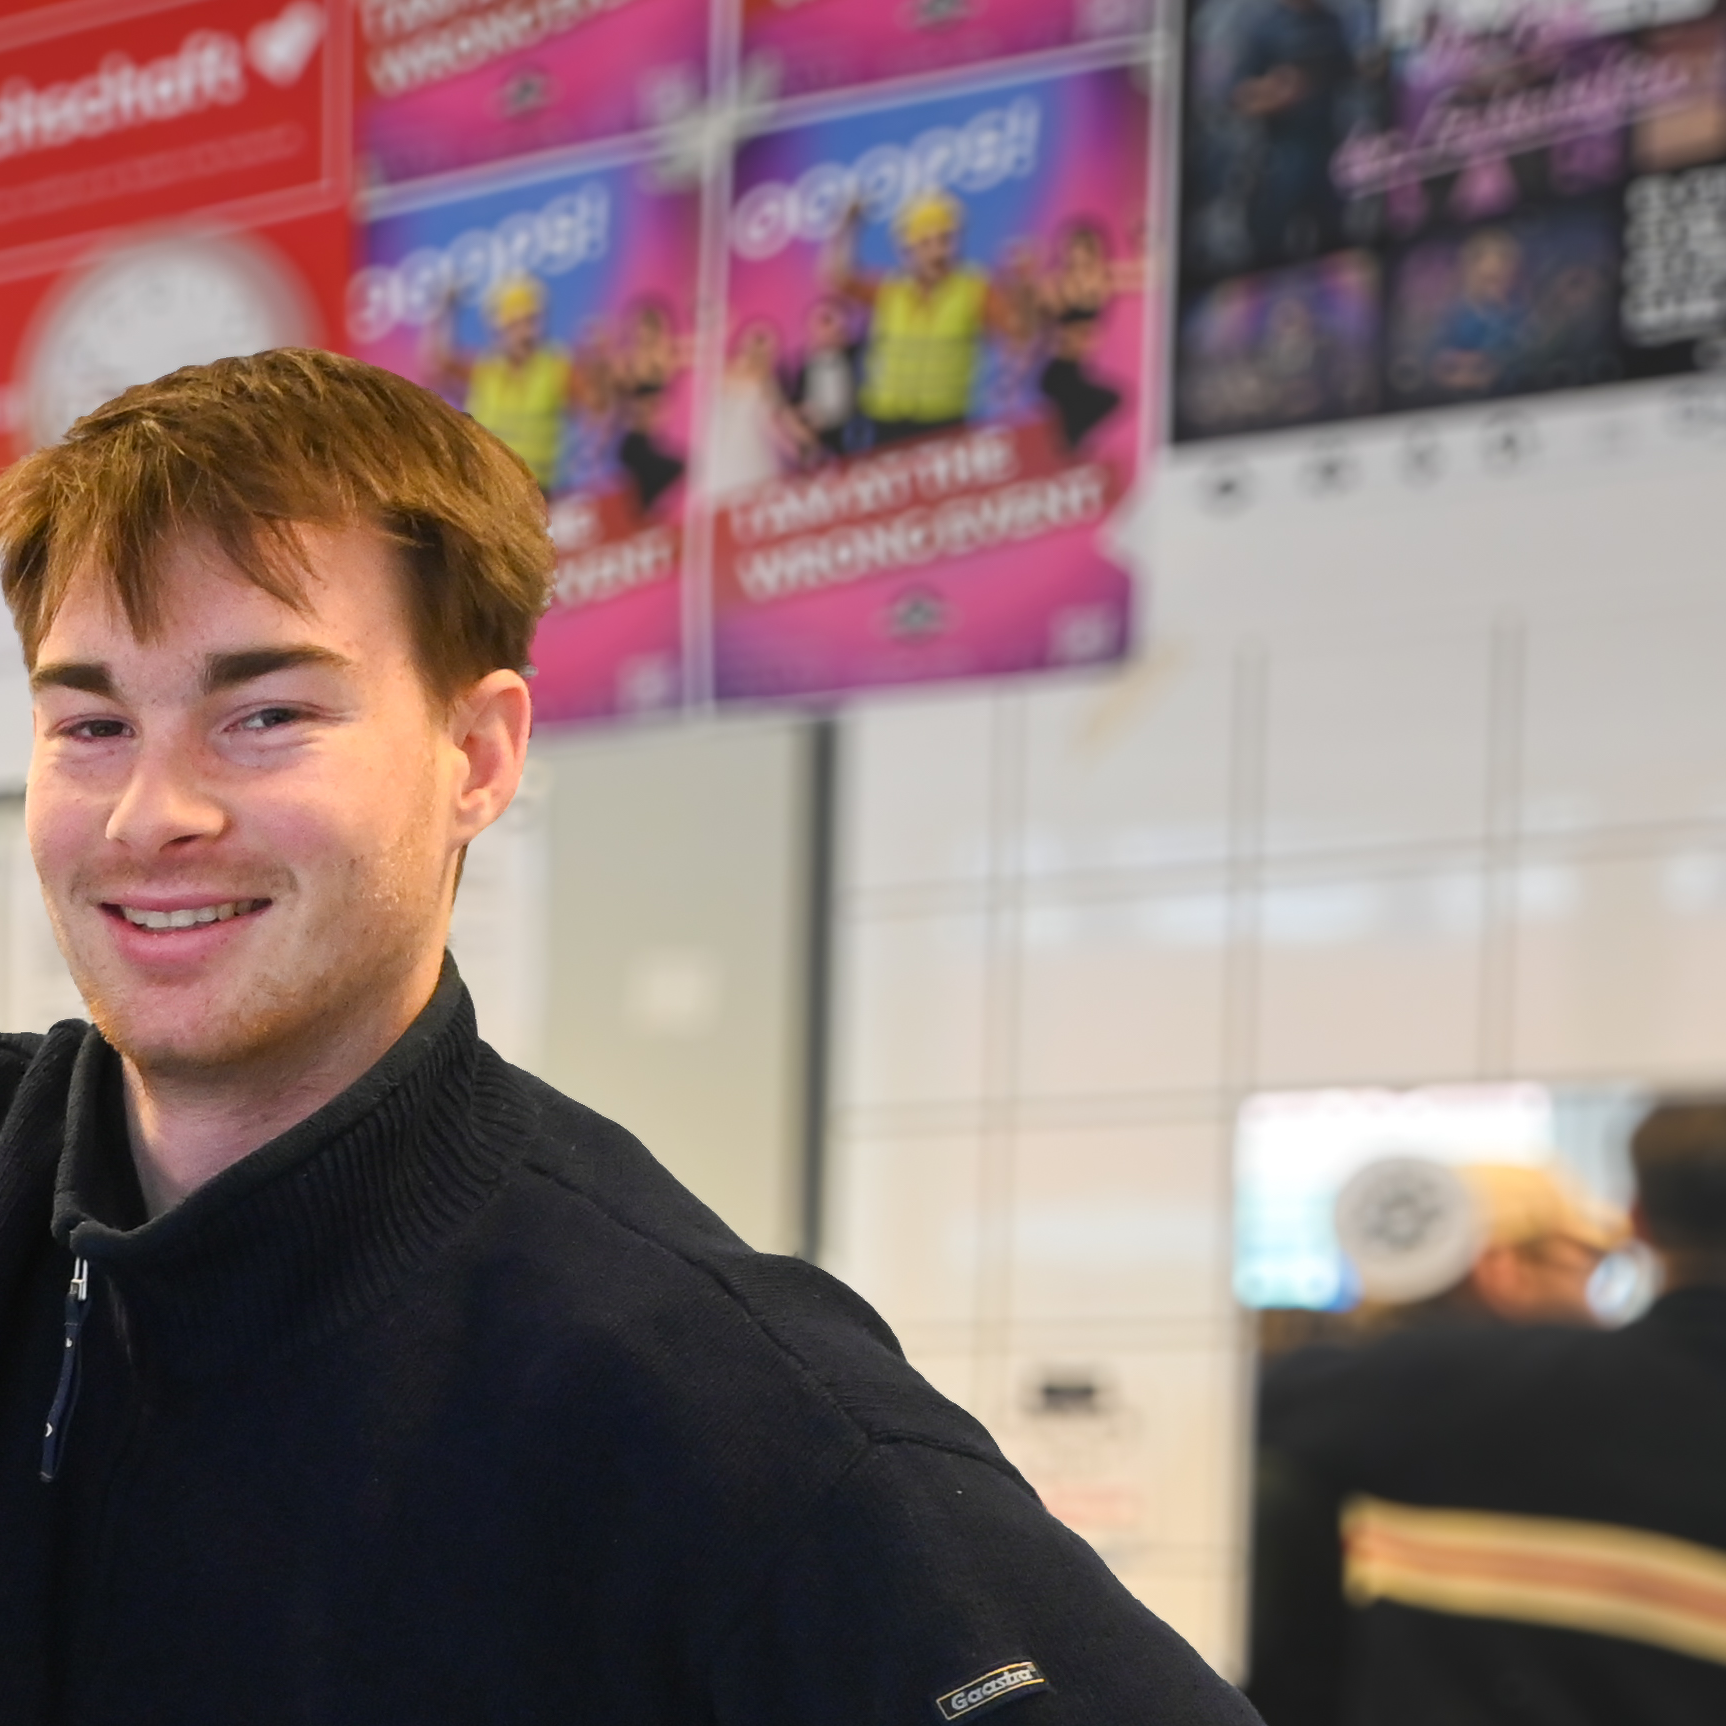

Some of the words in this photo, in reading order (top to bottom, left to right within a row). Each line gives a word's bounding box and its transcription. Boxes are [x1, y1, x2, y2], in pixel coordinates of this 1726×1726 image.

[736, 509, 940, 602] WRONG
[939, 464, 1109, 557] EVENT
[951, 1668, 1032, 1711] Gaastra
